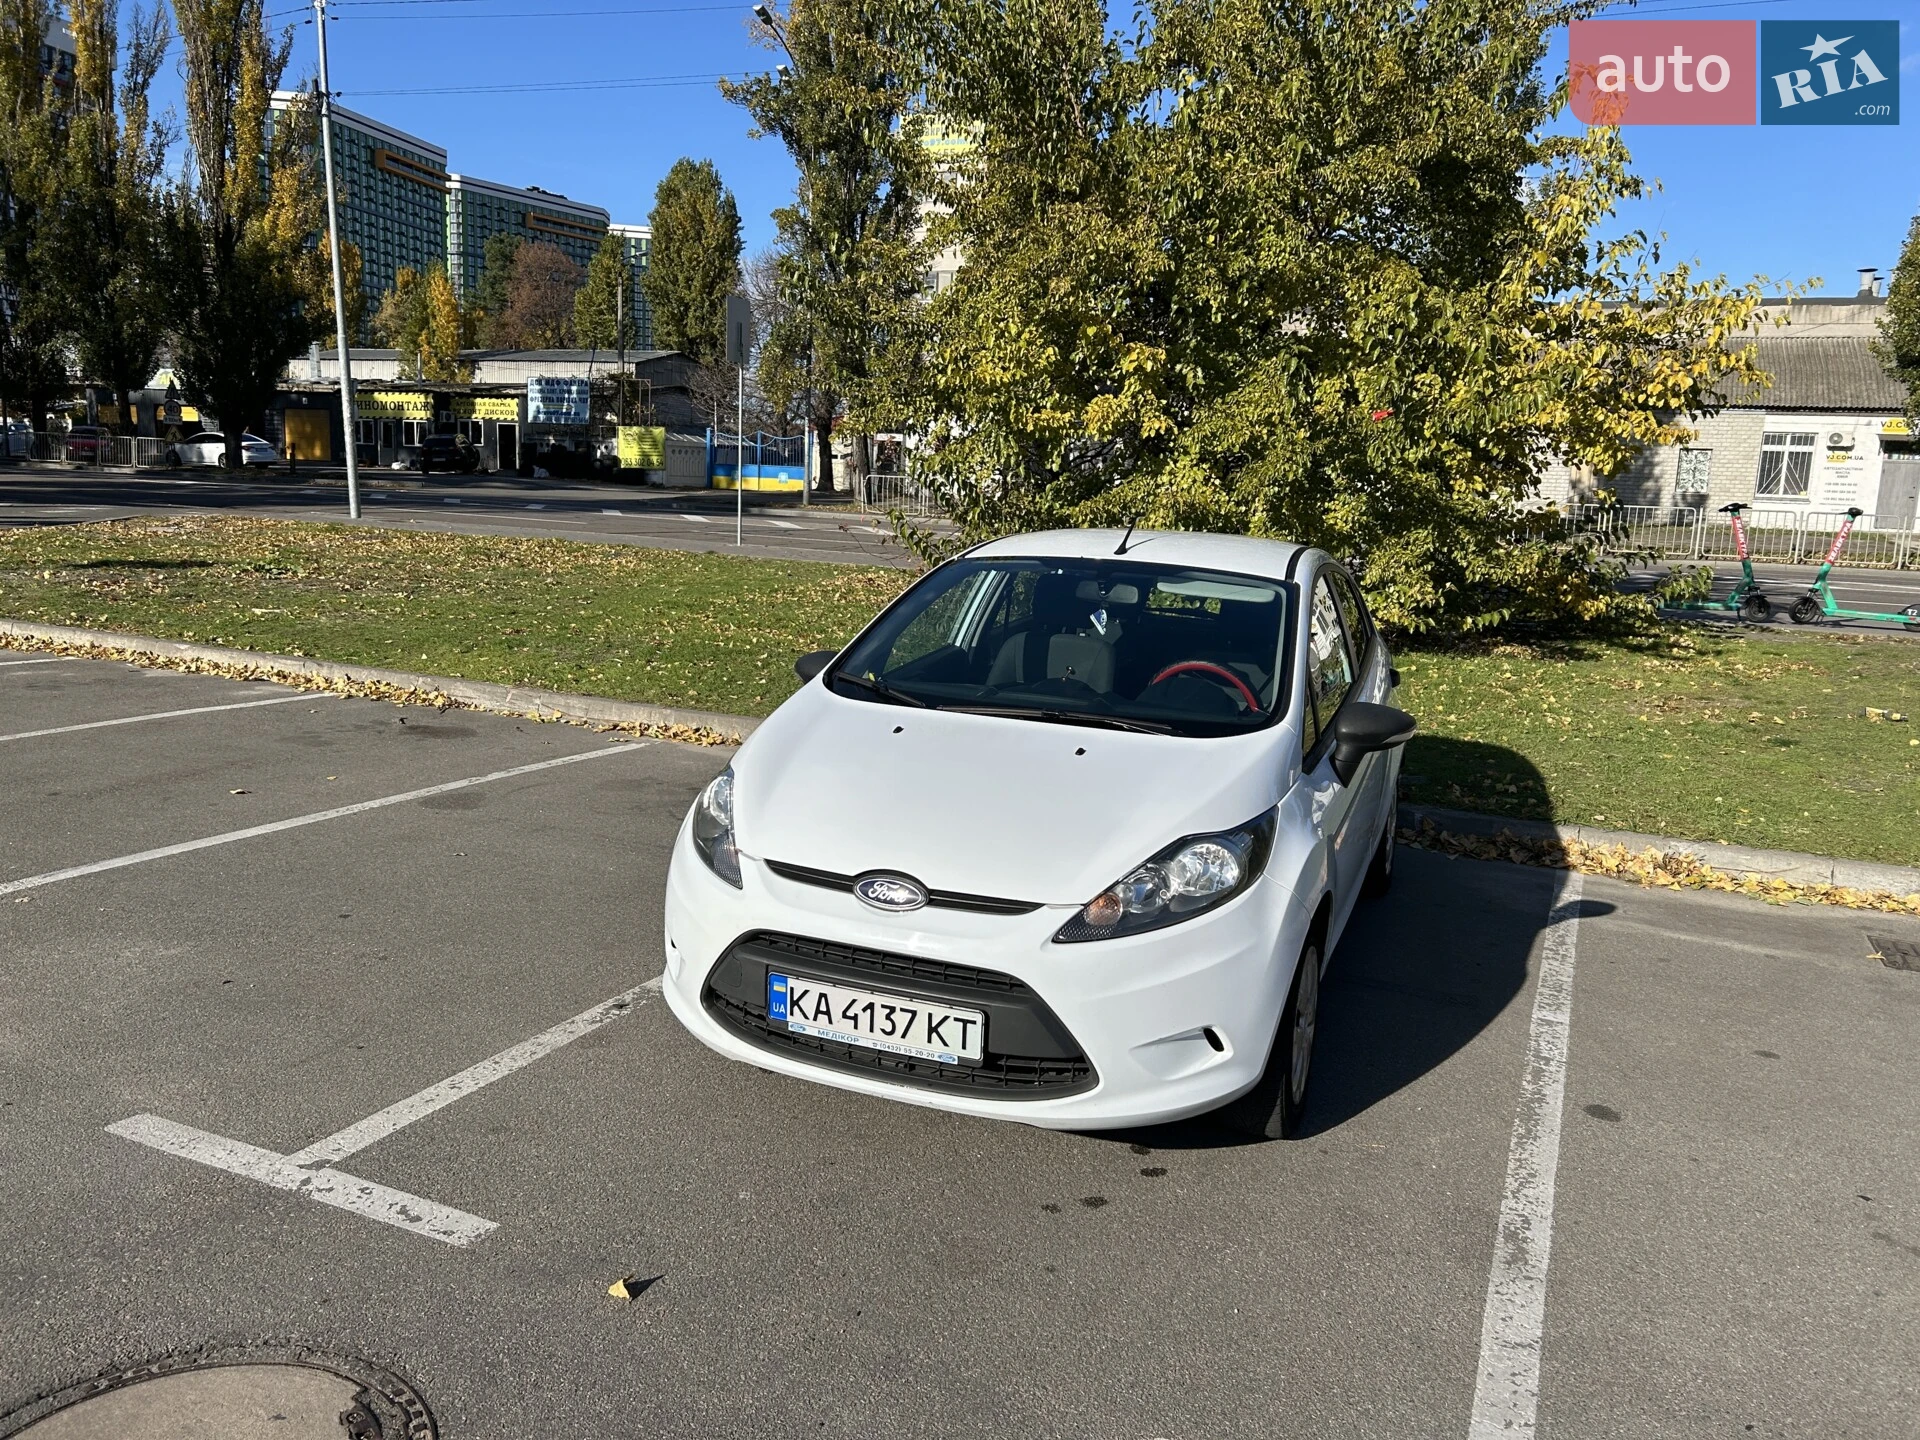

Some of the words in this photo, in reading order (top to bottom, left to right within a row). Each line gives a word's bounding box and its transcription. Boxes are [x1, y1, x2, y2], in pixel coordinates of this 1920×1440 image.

[168, 405, 178, 415] 40
[356, 400, 430, 411] ИНОМОНТАЖ
[634, 458, 646, 466] 302
[647, 458, 654, 466] 04
[656, 458, 664, 466] 54
[868, 881, 909, 903] Ford
[773, 1002, 786, 1014] UA
[790, 986, 833, 1025] KA
[842, 998, 918, 1039] 4137
[927, 1011, 977, 1050] KT
[818, 1030, 860, 1043] МЕДІКОР
[880, 1042, 902, 1052] (0432)
[904, 1048, 936, 1059] 55-20-20
